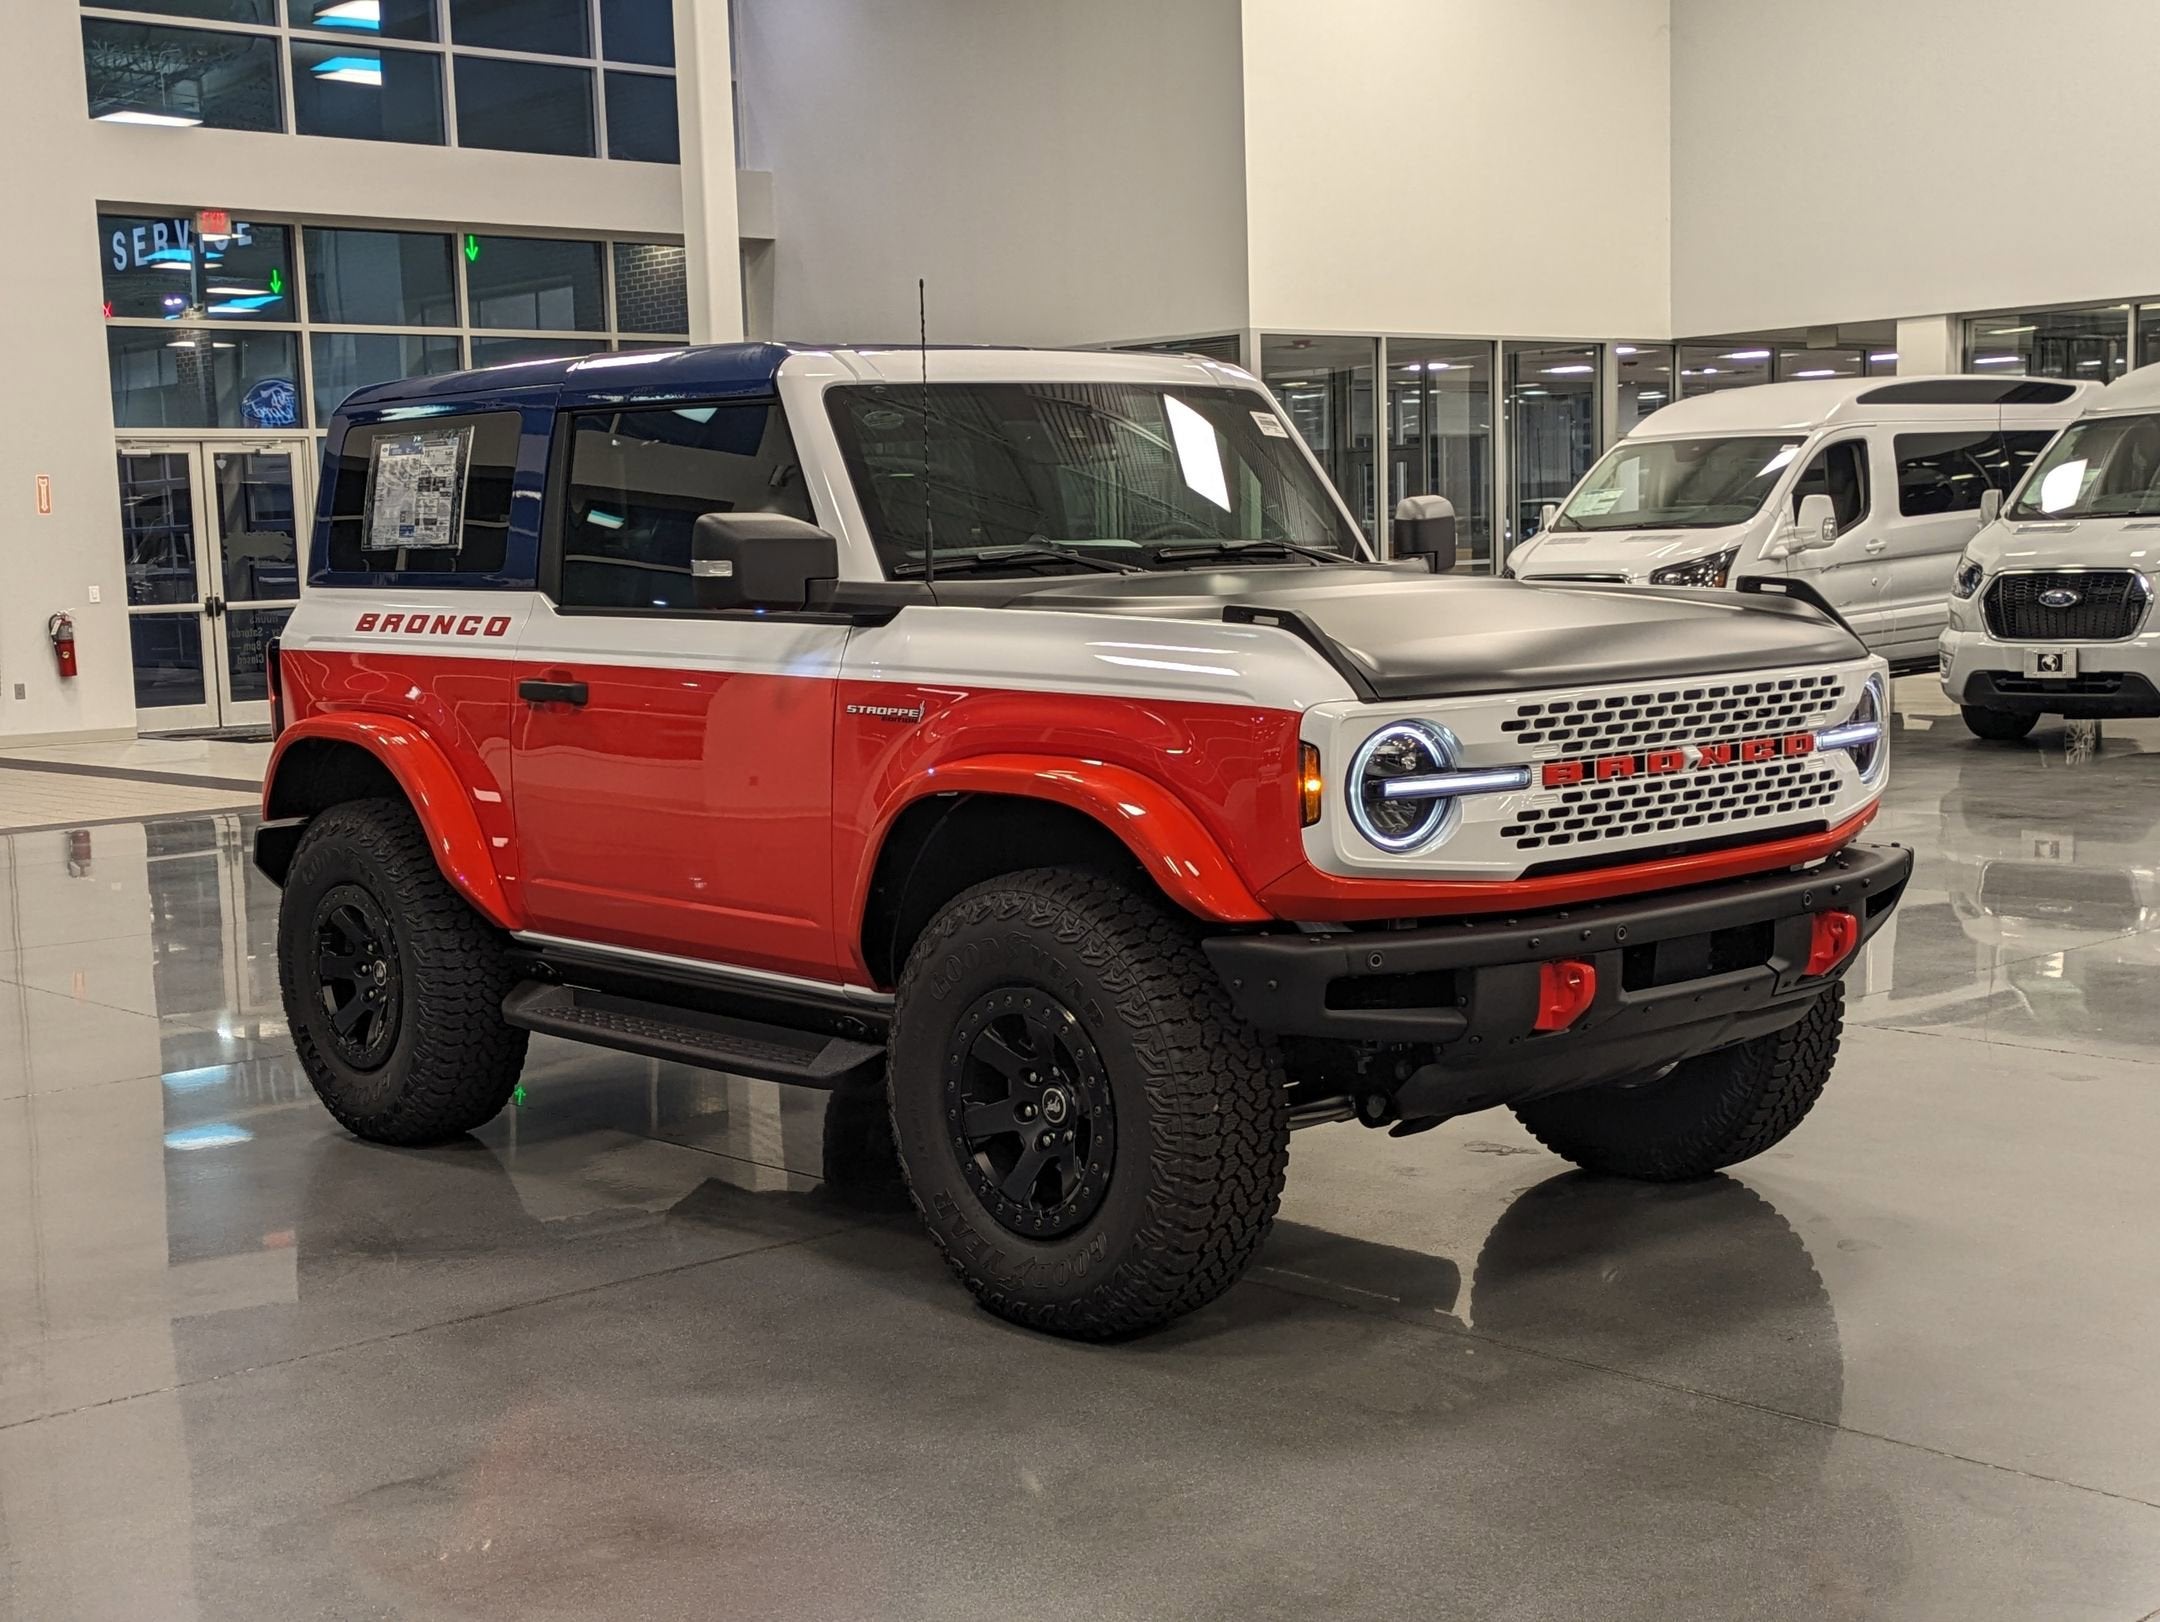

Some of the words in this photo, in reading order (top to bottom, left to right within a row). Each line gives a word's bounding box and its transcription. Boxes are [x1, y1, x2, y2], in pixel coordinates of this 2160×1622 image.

[354, 613, 512, 637] BRONCO
[846, 704, 920, 718] STROPPE
[1541, 732, 1815, 787] BRONCO
[930, 928, 1105, 1029] GOODYEAR
[934, 1186, 1112, 1293] GOODYEAR
